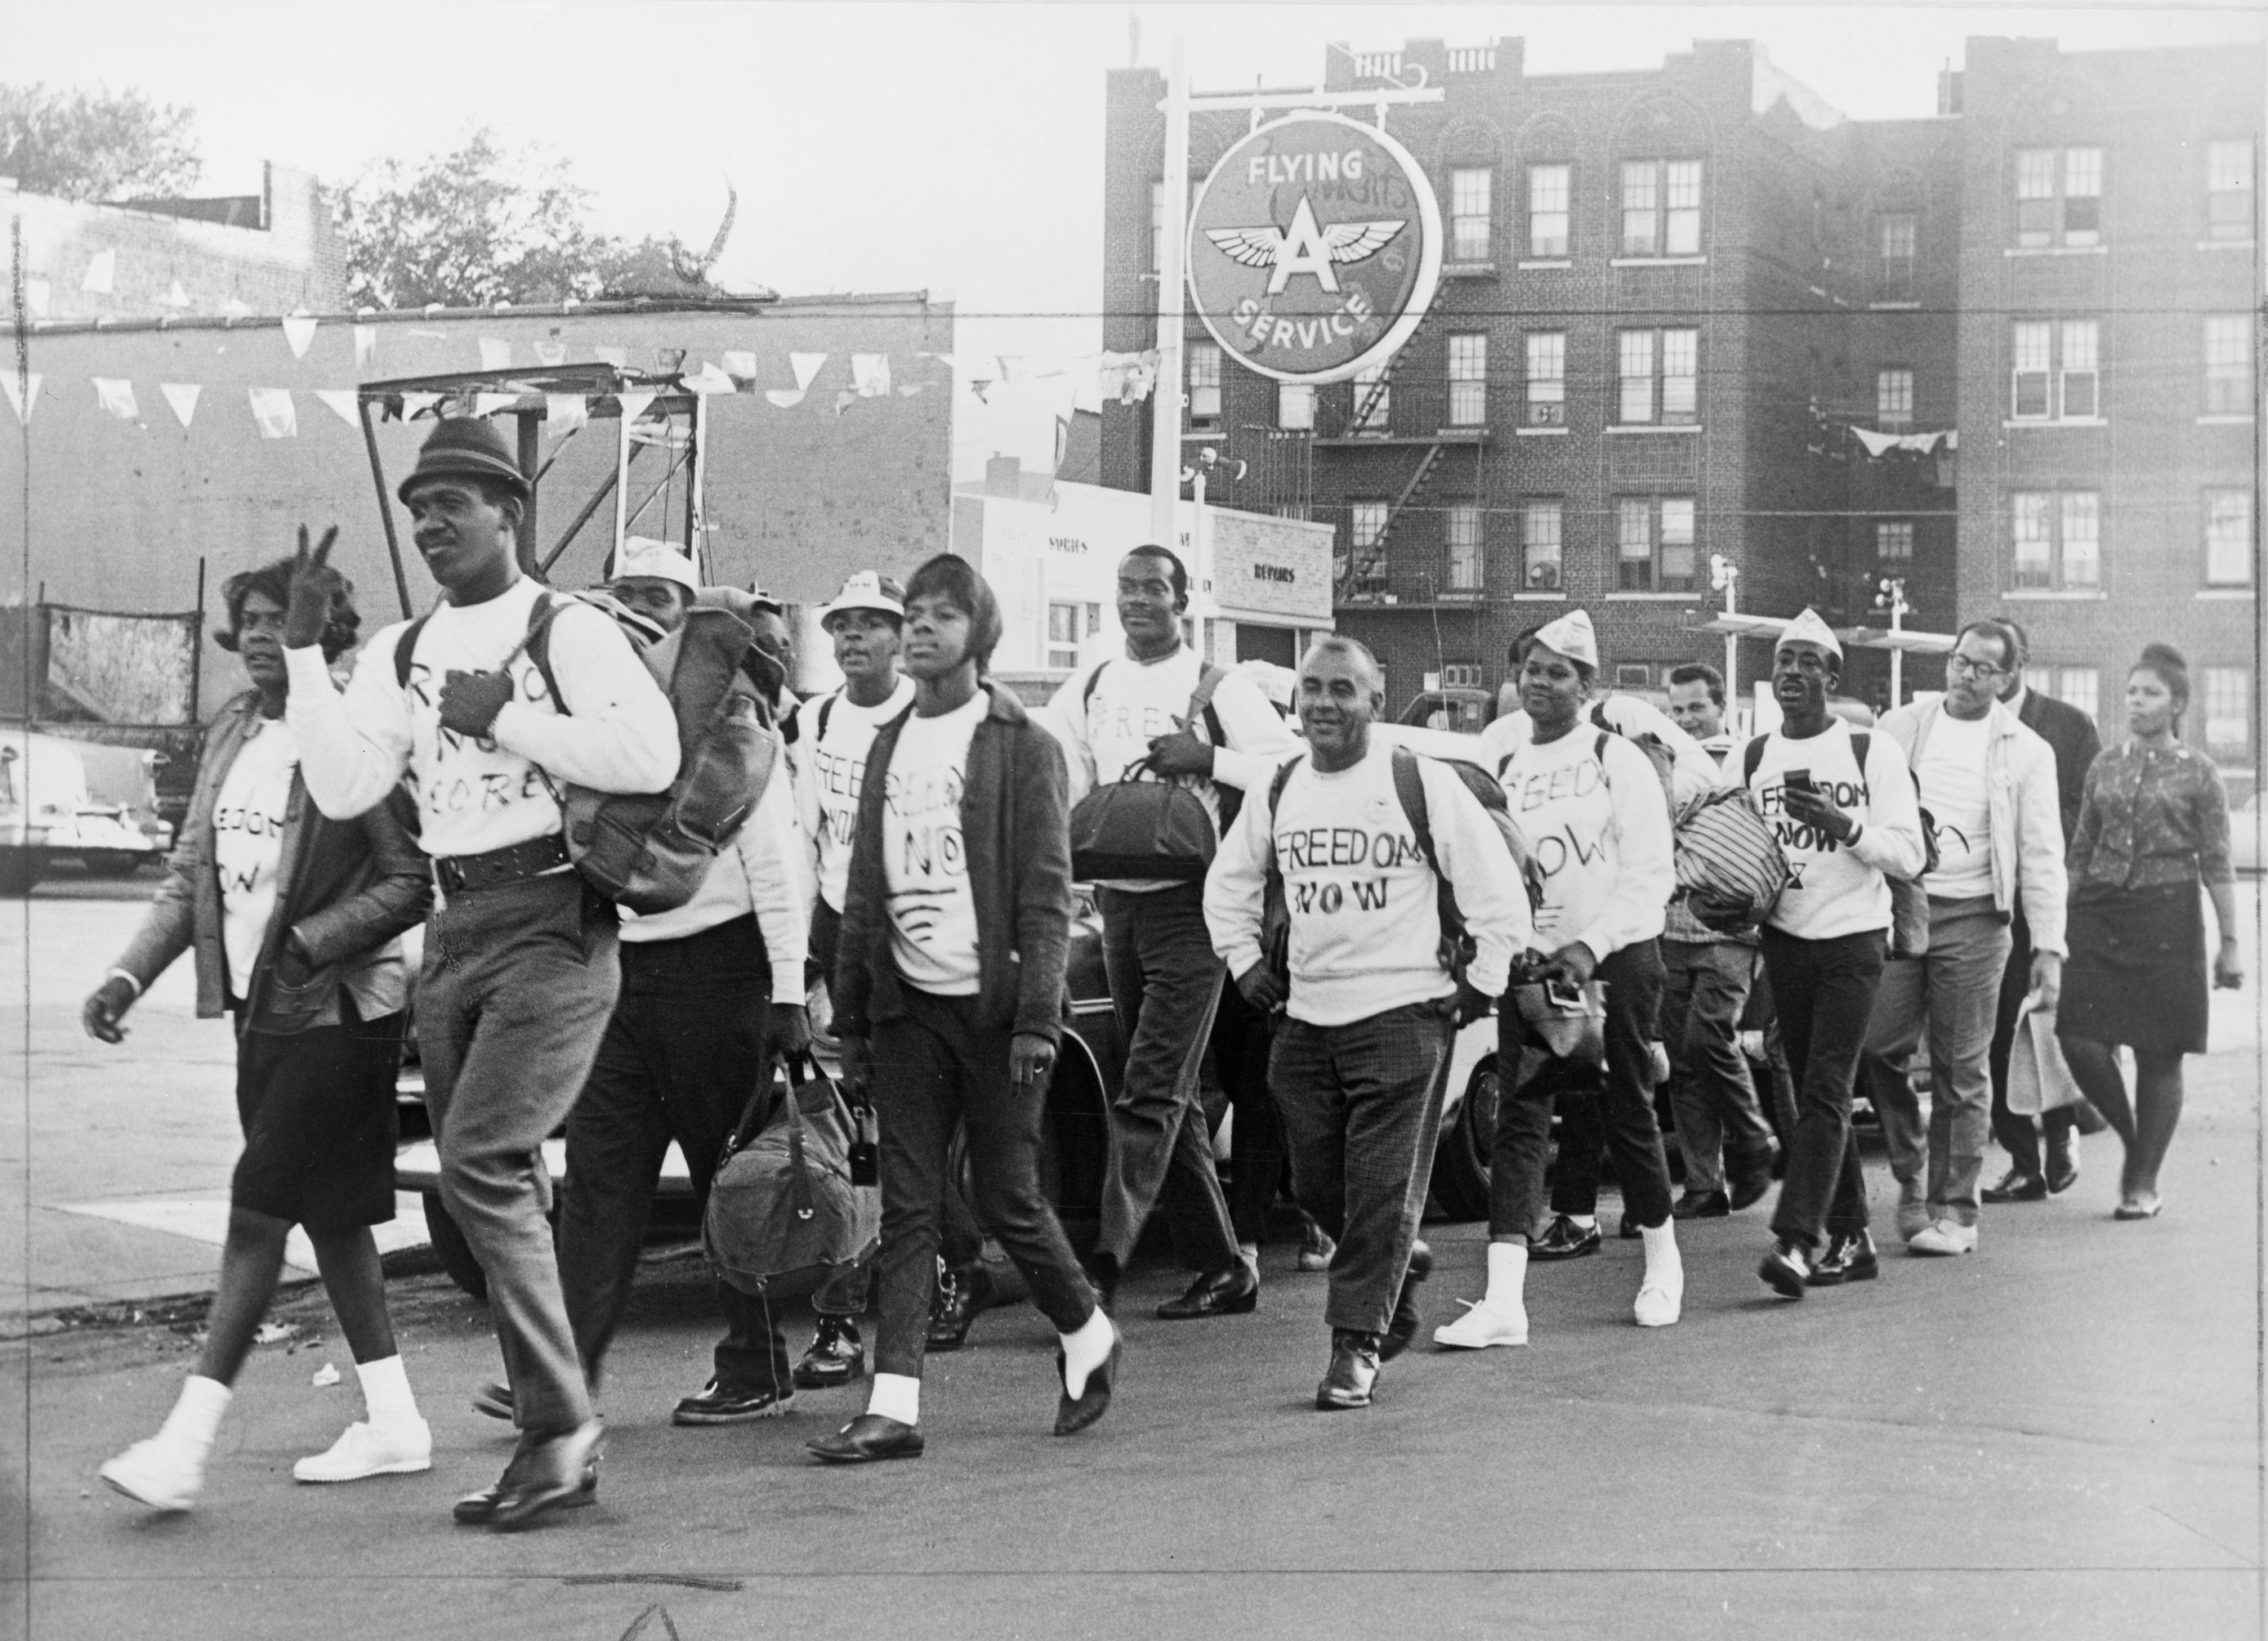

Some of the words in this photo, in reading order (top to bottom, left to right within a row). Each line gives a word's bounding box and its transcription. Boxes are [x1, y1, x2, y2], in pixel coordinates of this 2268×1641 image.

[1248, 150, 1364, 184] FLYING
[1230, 293, 1372, 350] SERVICE
[1279, 828, 1422, 870] FREEDOM
[1775, 821, 1837, 852] NOW
[1295, 877, 1388, 914] NOW
